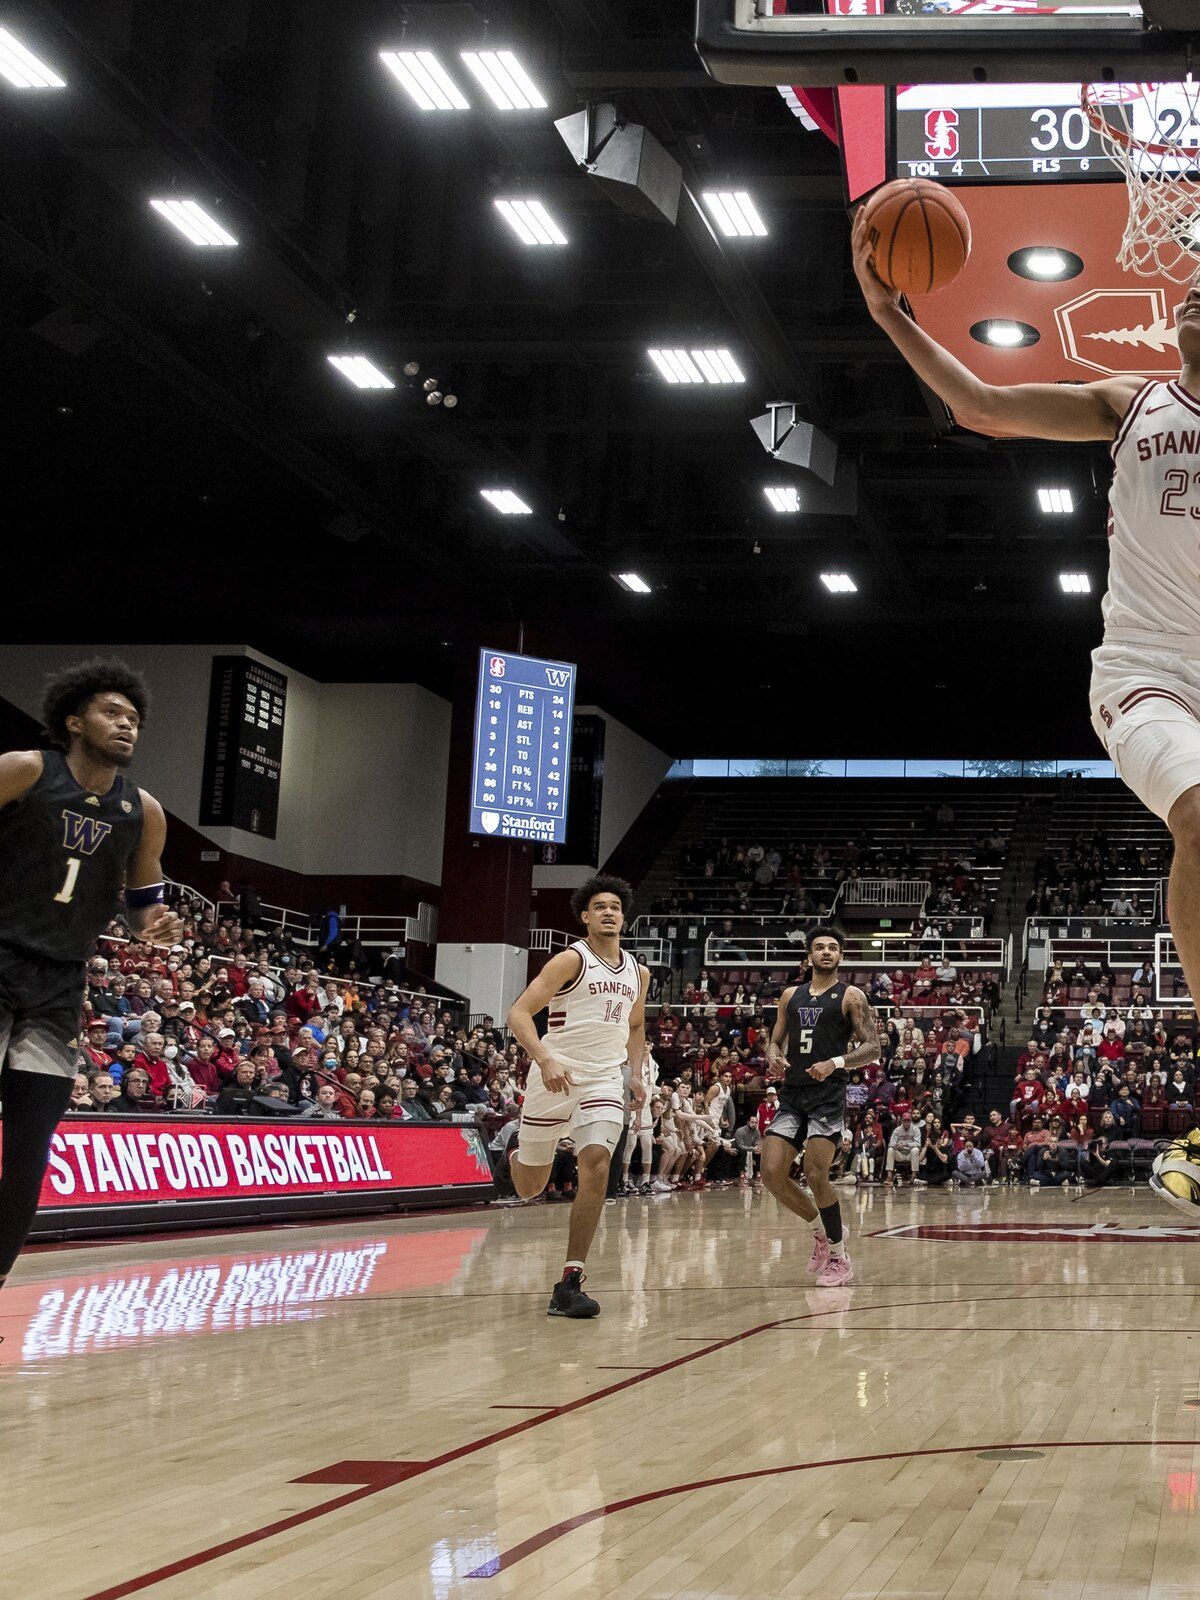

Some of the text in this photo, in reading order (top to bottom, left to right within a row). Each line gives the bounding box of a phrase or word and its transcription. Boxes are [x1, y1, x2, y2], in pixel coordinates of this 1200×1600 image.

[1030, 108, 1090, 151] 30
[908, 163, 939, 176] TOL
[951, 162, 964, 176] 4
[1032, 159, 1061, 173] FLS
[1080, 158, 1090, 171] 6
[545, 668, 571, 687] W
[489, 684, 564, 705] 30 PTS 24
[517, 704, 534, 715] REB
[552, 709, 564, 719] 14
[517, 719, 533, 731] AST
[553, 726, 561, 735] 2
[489, 731, 559, 750] 3 STL 4
[488, 747, 496, 757] 7
[517, 750, 528, 760] TO
[512, 764, 523, 775] FG
[523, 766, 532, 776] %
[547, 771, 560, 781] 42
[512, 780, 523, 790] FT
[523, 782, 532, 792] %
[525, 797, 534, 807] %
[546, 801, 559, 811] 17
[62, 809, 112, 855] W
[502, 814, 555, 832] Stanford
[502, 827, 555, 841] MEDICINE
[53, 857, 82, 904] 1
[588, 981, 636, 1002] STANFORD
[604, 1000, 623, 1024] 14
[798, 1007, 823, 1026] W
[800, 1029, 813, 1053] 5
[49, 1131, 393, 1196] STANFORD BASKETBALL
